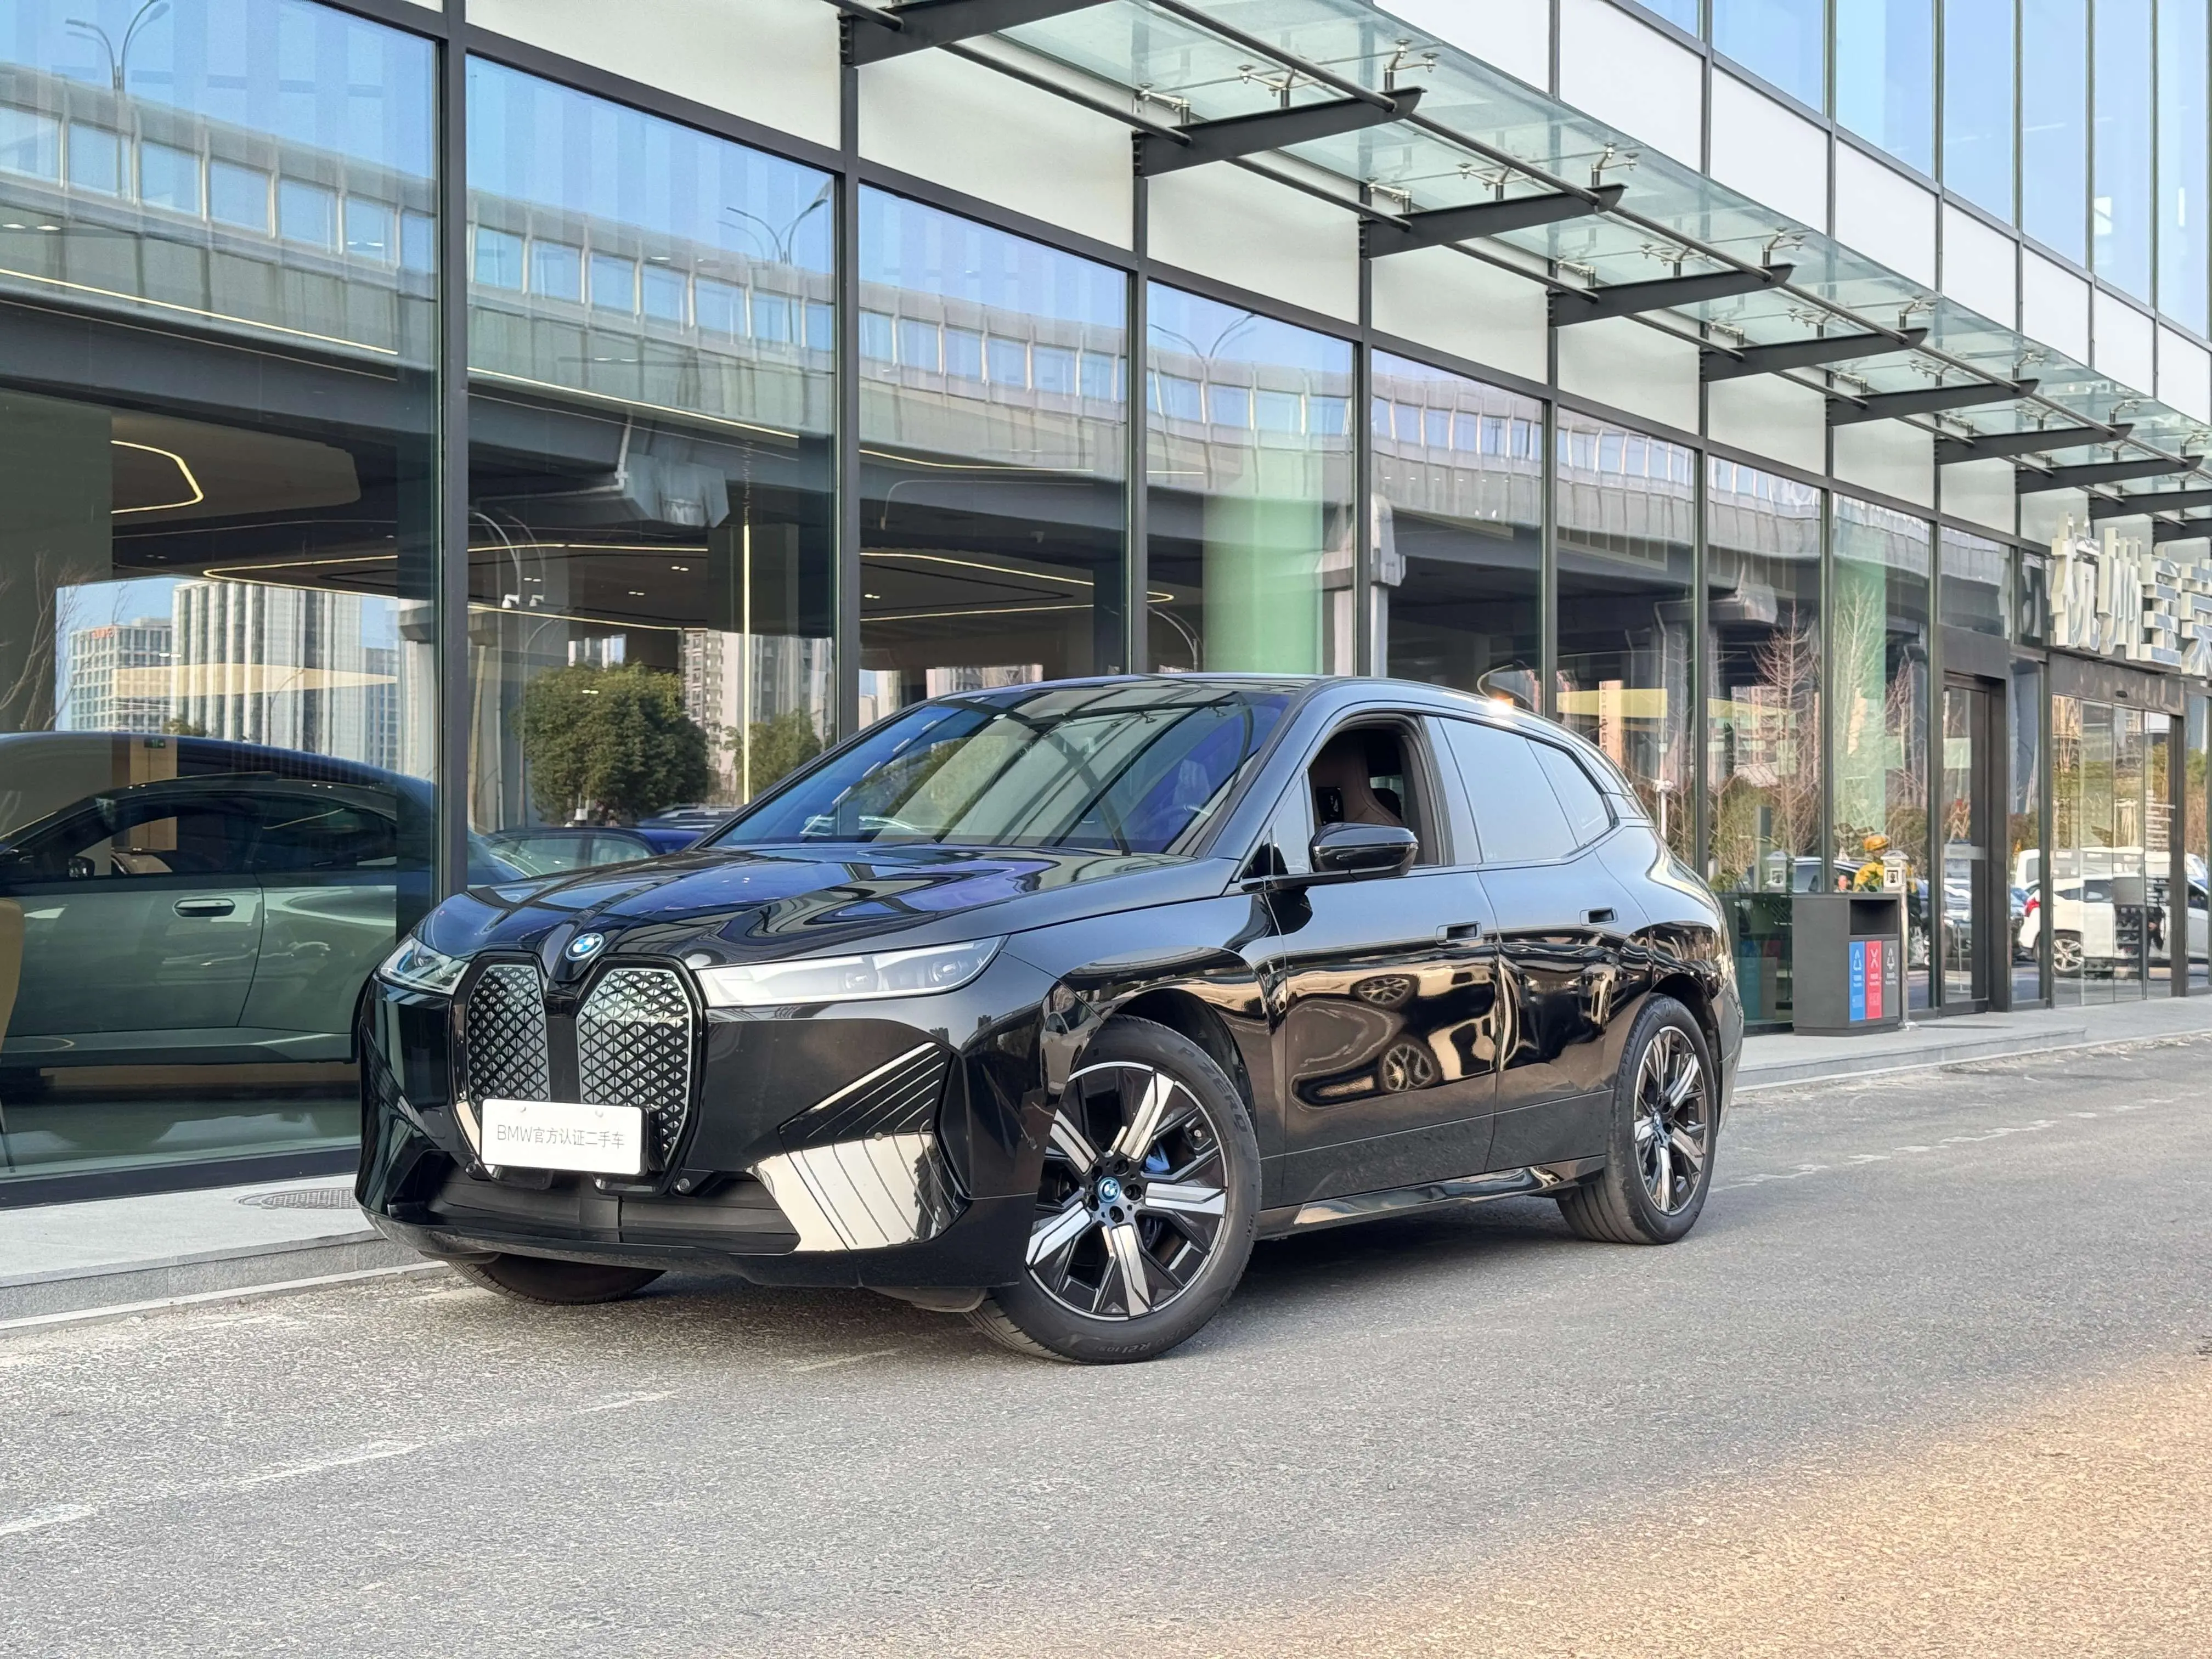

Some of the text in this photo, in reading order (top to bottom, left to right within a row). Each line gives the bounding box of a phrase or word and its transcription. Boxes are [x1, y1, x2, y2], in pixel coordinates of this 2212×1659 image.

[1198, 1062, 1249, 1132] ZERO
[497, 1124, 625, 1150] BMW官方认证二手车
